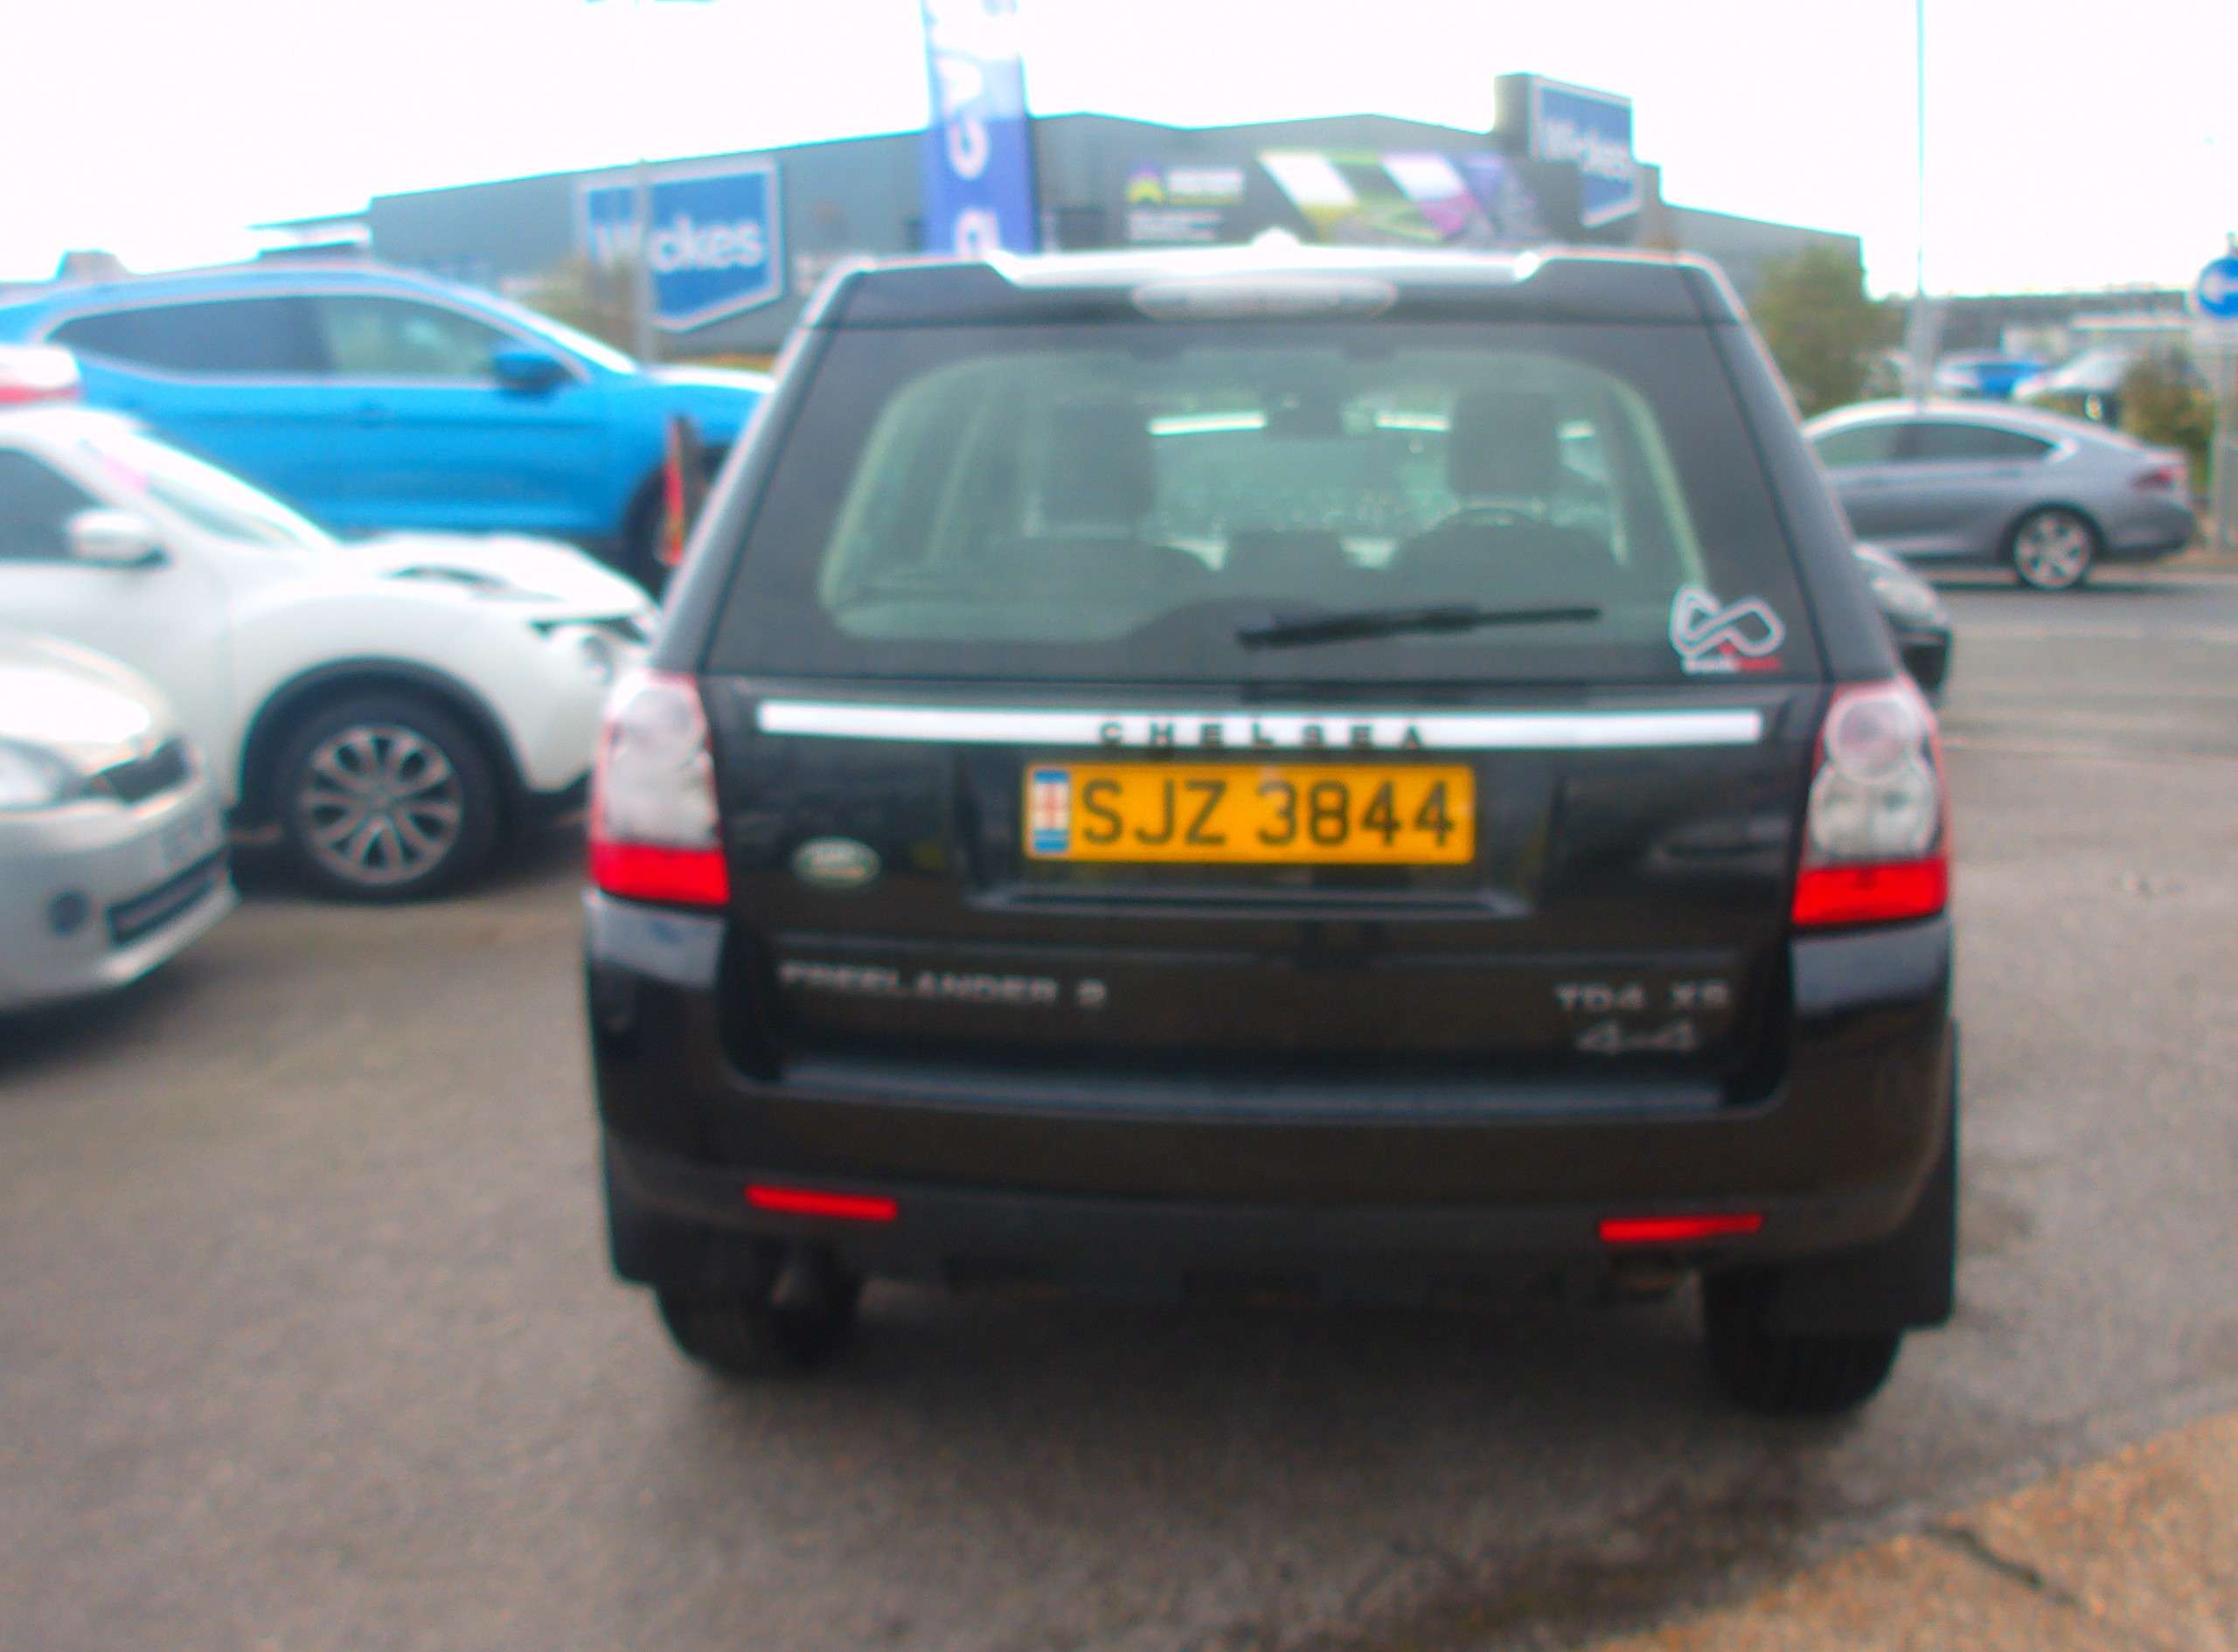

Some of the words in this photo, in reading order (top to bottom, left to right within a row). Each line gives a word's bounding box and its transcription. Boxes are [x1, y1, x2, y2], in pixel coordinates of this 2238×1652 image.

[594, 214, 761, 270] Wckes
[1099, 721, 1424, 751] CHELSEA
[1081, 779, 1226, 846] SJZ
[1256, 780, 1456, 848] 3844
